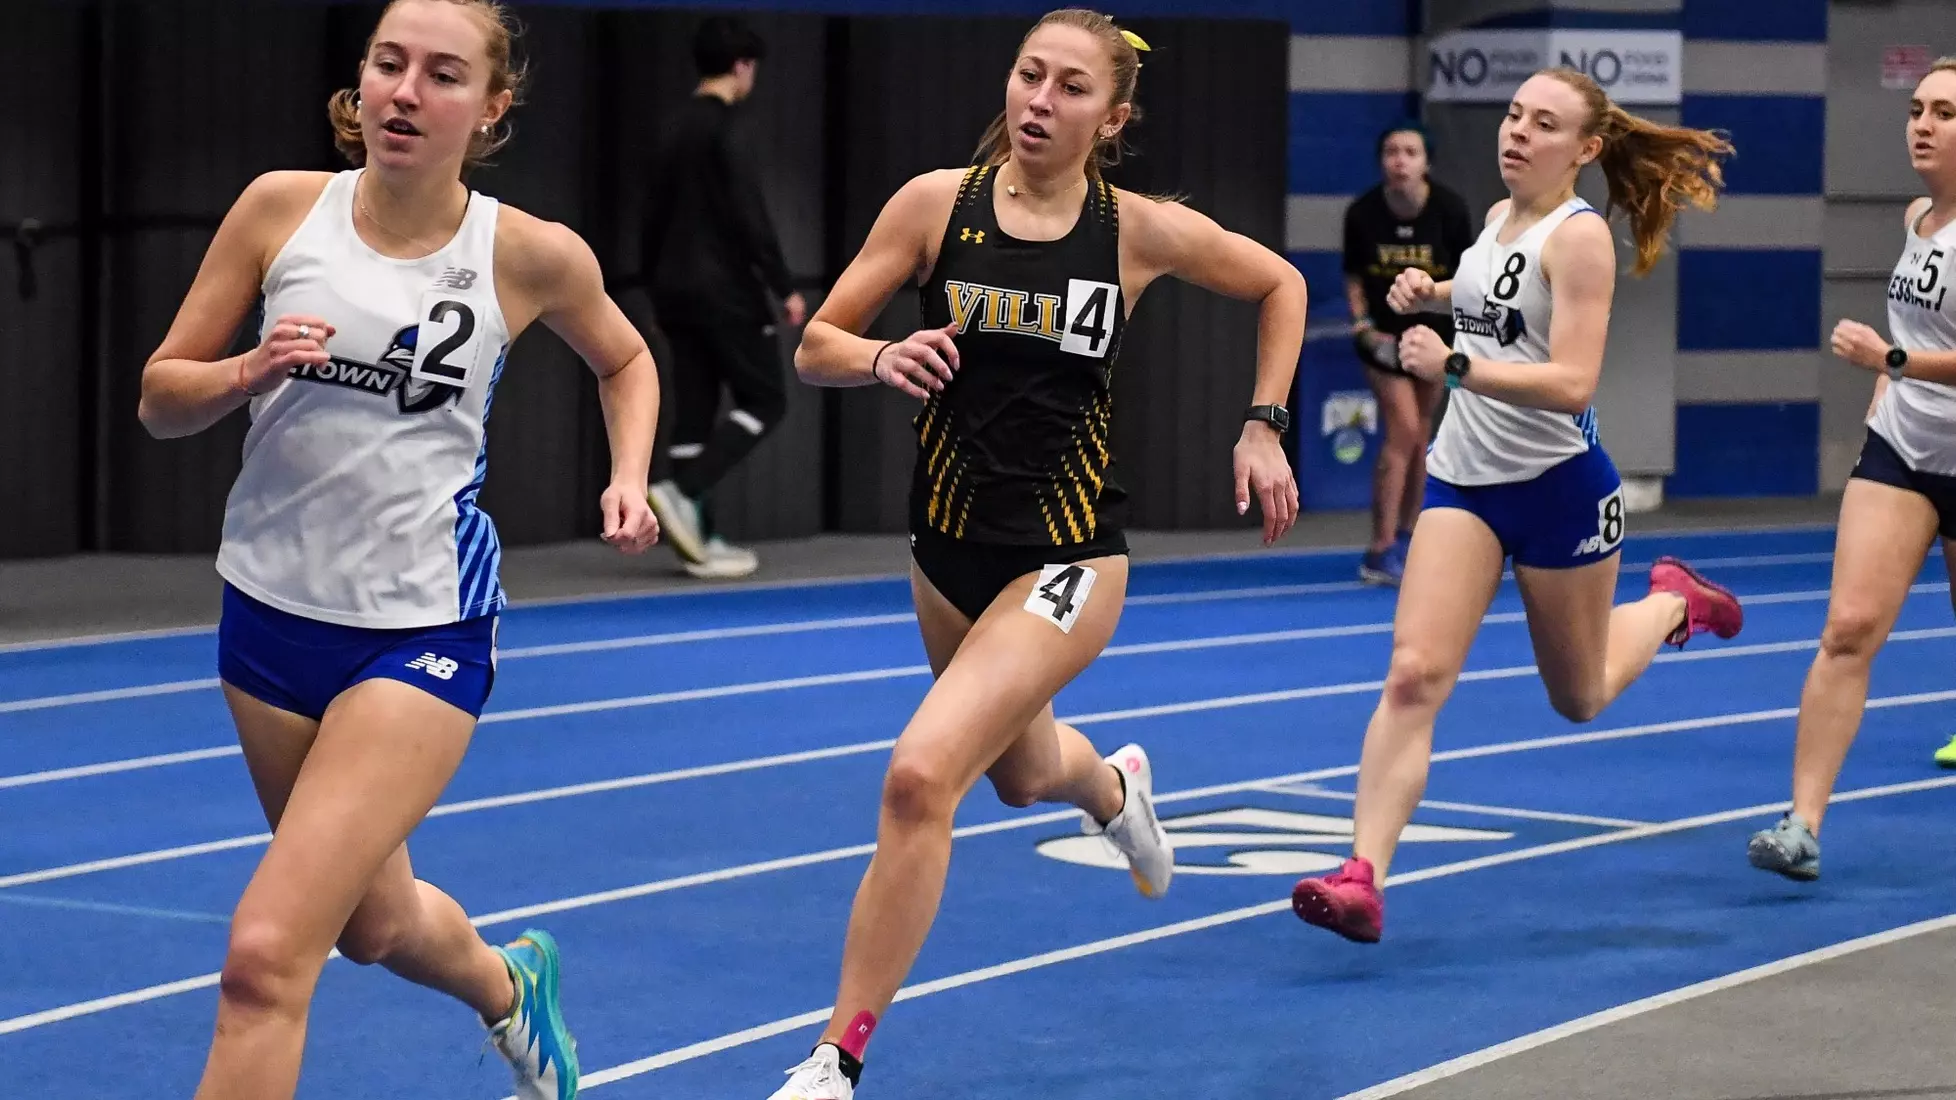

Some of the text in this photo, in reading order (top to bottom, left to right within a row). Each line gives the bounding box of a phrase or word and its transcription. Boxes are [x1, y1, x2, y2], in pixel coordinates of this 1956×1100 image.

[1431, 49, 1487, 86] NO
[1560, 49, 1622, 87] NO
[1493, 252, 1526, 300] 8
[1917, 248, 1945, 293] 5
[946, 280, 1066, 343] VILL
[1070, 287, 1109, 351] 4
[420, 300, 476, 381] 2
[289, 360, 392, 390] TOWN
[1603, 495, 1622, 544] 8
[1039, 565, 1085, 622] 4
